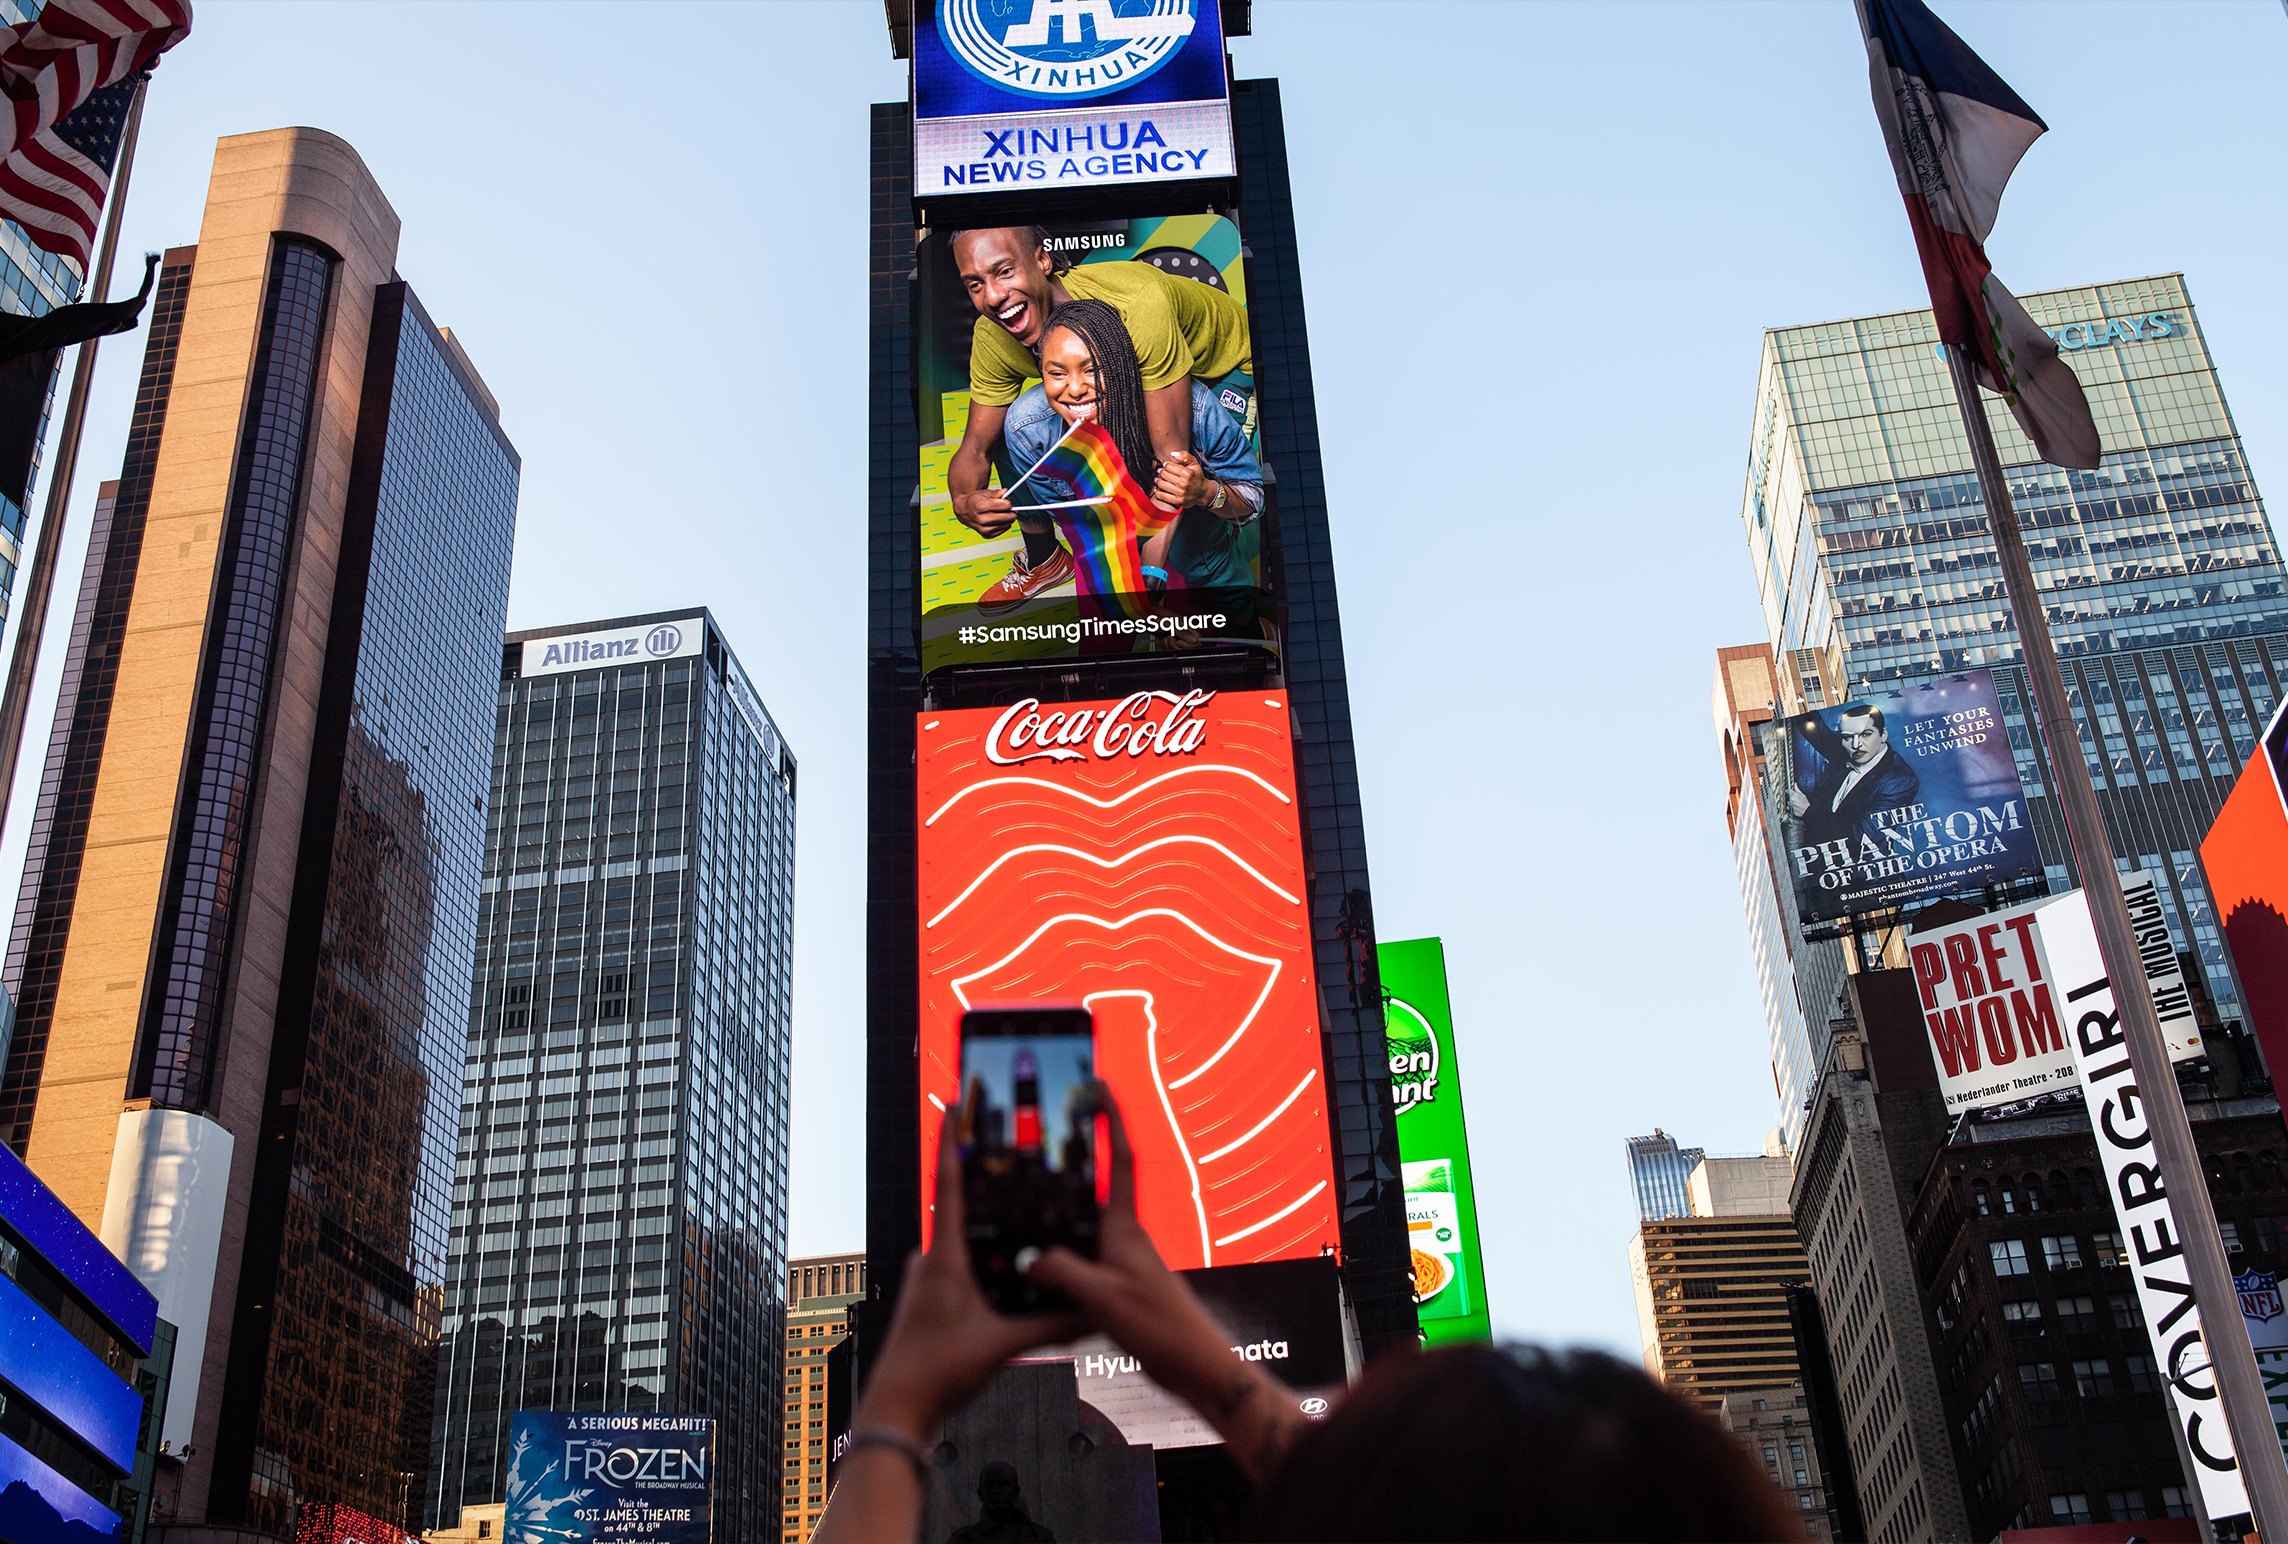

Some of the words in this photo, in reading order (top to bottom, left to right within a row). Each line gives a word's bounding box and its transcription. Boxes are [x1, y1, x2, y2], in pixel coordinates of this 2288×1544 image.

[1004, 50, 1149, 88] XINHUA
[982, 120, 1167, 159] XINHUA
[943, 159, 1048, 187] NEWS
[1058, 148, 1210, 180] AGENCY
[1043, 233, 1126, 252] SAMSUNG
[1222, 390, 1244, 409] FILA
[958, 613, 1227, 645] #SamsungTimesSquare
[541, 637, 640, 667] Allianz
[985, 688, 1218, 765] Coca-Cola
[1903, 718, 1936, 736] LET
[1941, 706, 1991, 726] YOUR
[1903, 717, 1995, 748] FANTASIES
[1917, 732, 1987, 758] UNWIND
[1870, 802, 1928, 830] THE
[1790, 800, 2024, 878] PHANTOM
[1819, 867, 1854, 891] OF
[1857, 855, 1914, 882] THE
[1916, 836, 2008, 869] OPERA
[1848, 885, 1888, 900] MAJESTIC
[1888, 876, 1928, 891] THEATRE
[1934, 872, 1948, 882] 247
[1949, 868, 1967, 878] West
[1967, 864, 1983, 874] 44th
[1984, 863, 1995, 871] St.
[2123, 879, 2180, 980] MUSICAL
[1926, 982, 2071, 1078] WOM
[1957, 1082, 2010, 1103] Nederlander
[2012, 1072, 2048, 1090] Theatre
[2055, 1065, 2074, 1079] 208
[2240, 1291, 2281, 1316] NFL
[581, 1417, 639, 1431] SERIOUS
[590, 1438, 612, 1449] Disney
[564, 1440, 706, 1489] FROZEN
[635, 1481, 646, 1489] THE
[647, 1481, 679, 1489] BROADWAY
[680, 1482, 705, 1490] MUSICAL
[585, 1509, 600, 1522] ST.
[603, 1508, 639, 1521] JAMES
[642, 1508, 691, 1521] THEATRE
[618, 1498, 635, 1508] Visit
[636, 1498, 649, 1508] the
[604, 1524, 614, 1533] on
[615, 1522, 636, 1533] 44TH
[638, 1522, 645, 1533] &
[646, 1522, 660, 1533] 8TH
